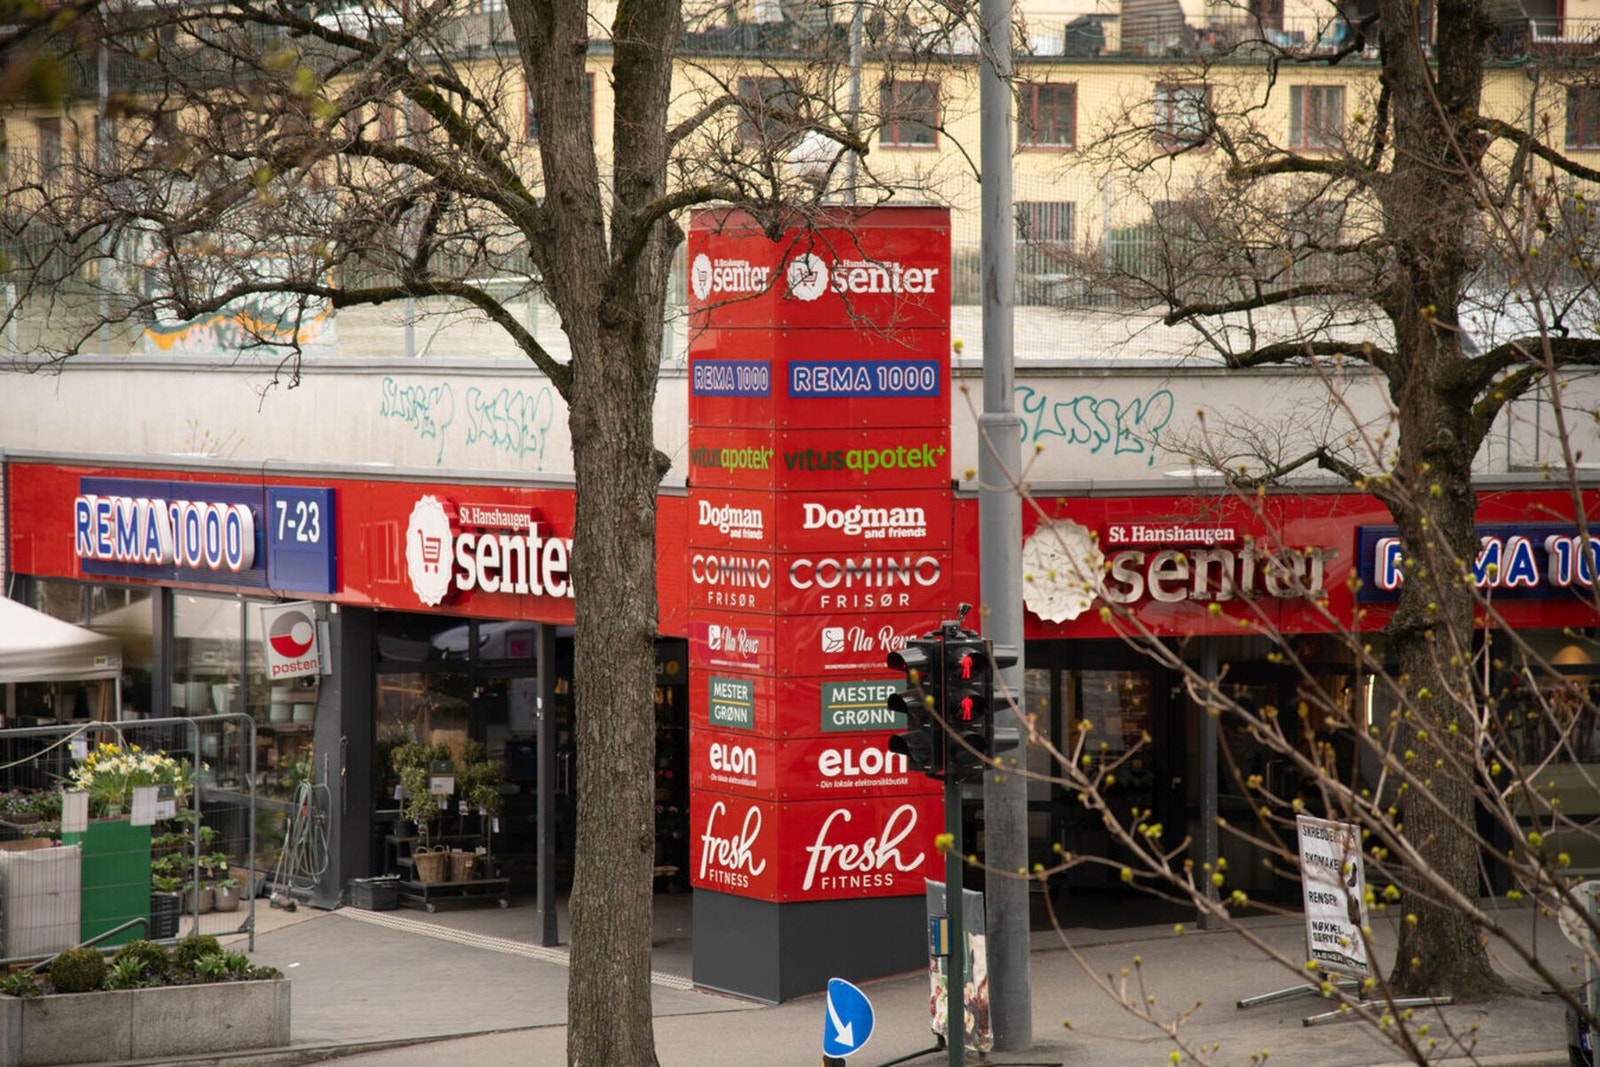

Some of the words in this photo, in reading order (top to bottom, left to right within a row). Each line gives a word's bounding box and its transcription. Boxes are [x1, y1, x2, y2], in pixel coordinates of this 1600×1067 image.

[713, 261, 770, 292] senter
[831, 262, 939, 293] senter
[694, 365, 735, 391] REMA
[737, 365, 769, 391] 1000
[793, 366, 872, 392] REMA
[878, 366, 936, 391] 1000
[276, 500, 320, 543] 7-23
[460, 507, 472, 524] St.
[472, 508, 531, 531] Hanshaugen
[698, 499, 763, 534] Dogman
[803, 503, 926, 536] Dogman
[75, 494, 172, 565] REMA
[170, 500, 253, 572] 1000
[865, 528, 886, 539] and
[888, 528, 926, 538] friends
[1109, 526, 1129, 543] St.
[1132, 526, 1235, 544] Hanshaugen
[692, 554, 771, 589] COMINO
[789, 556, 941, 590] COMINO
[1375, 536, 1540, 591] RMA
[708, 591, 755, 608] FRISØR
[821, 593, 910, 609] FRISØR
[272, 659, 317, 677] posten
[714, 682, 749, 701] MESTER
[714, 705, 747, 723] GRØNN
[832, 709, 895, 726] GRØNN
[700, 801, 766, 879] fresh
[802, 804, 925, 891] fresh
[709, 868, 749, 888] FITNESS
[821, 873, 894, 890] FITNESS
